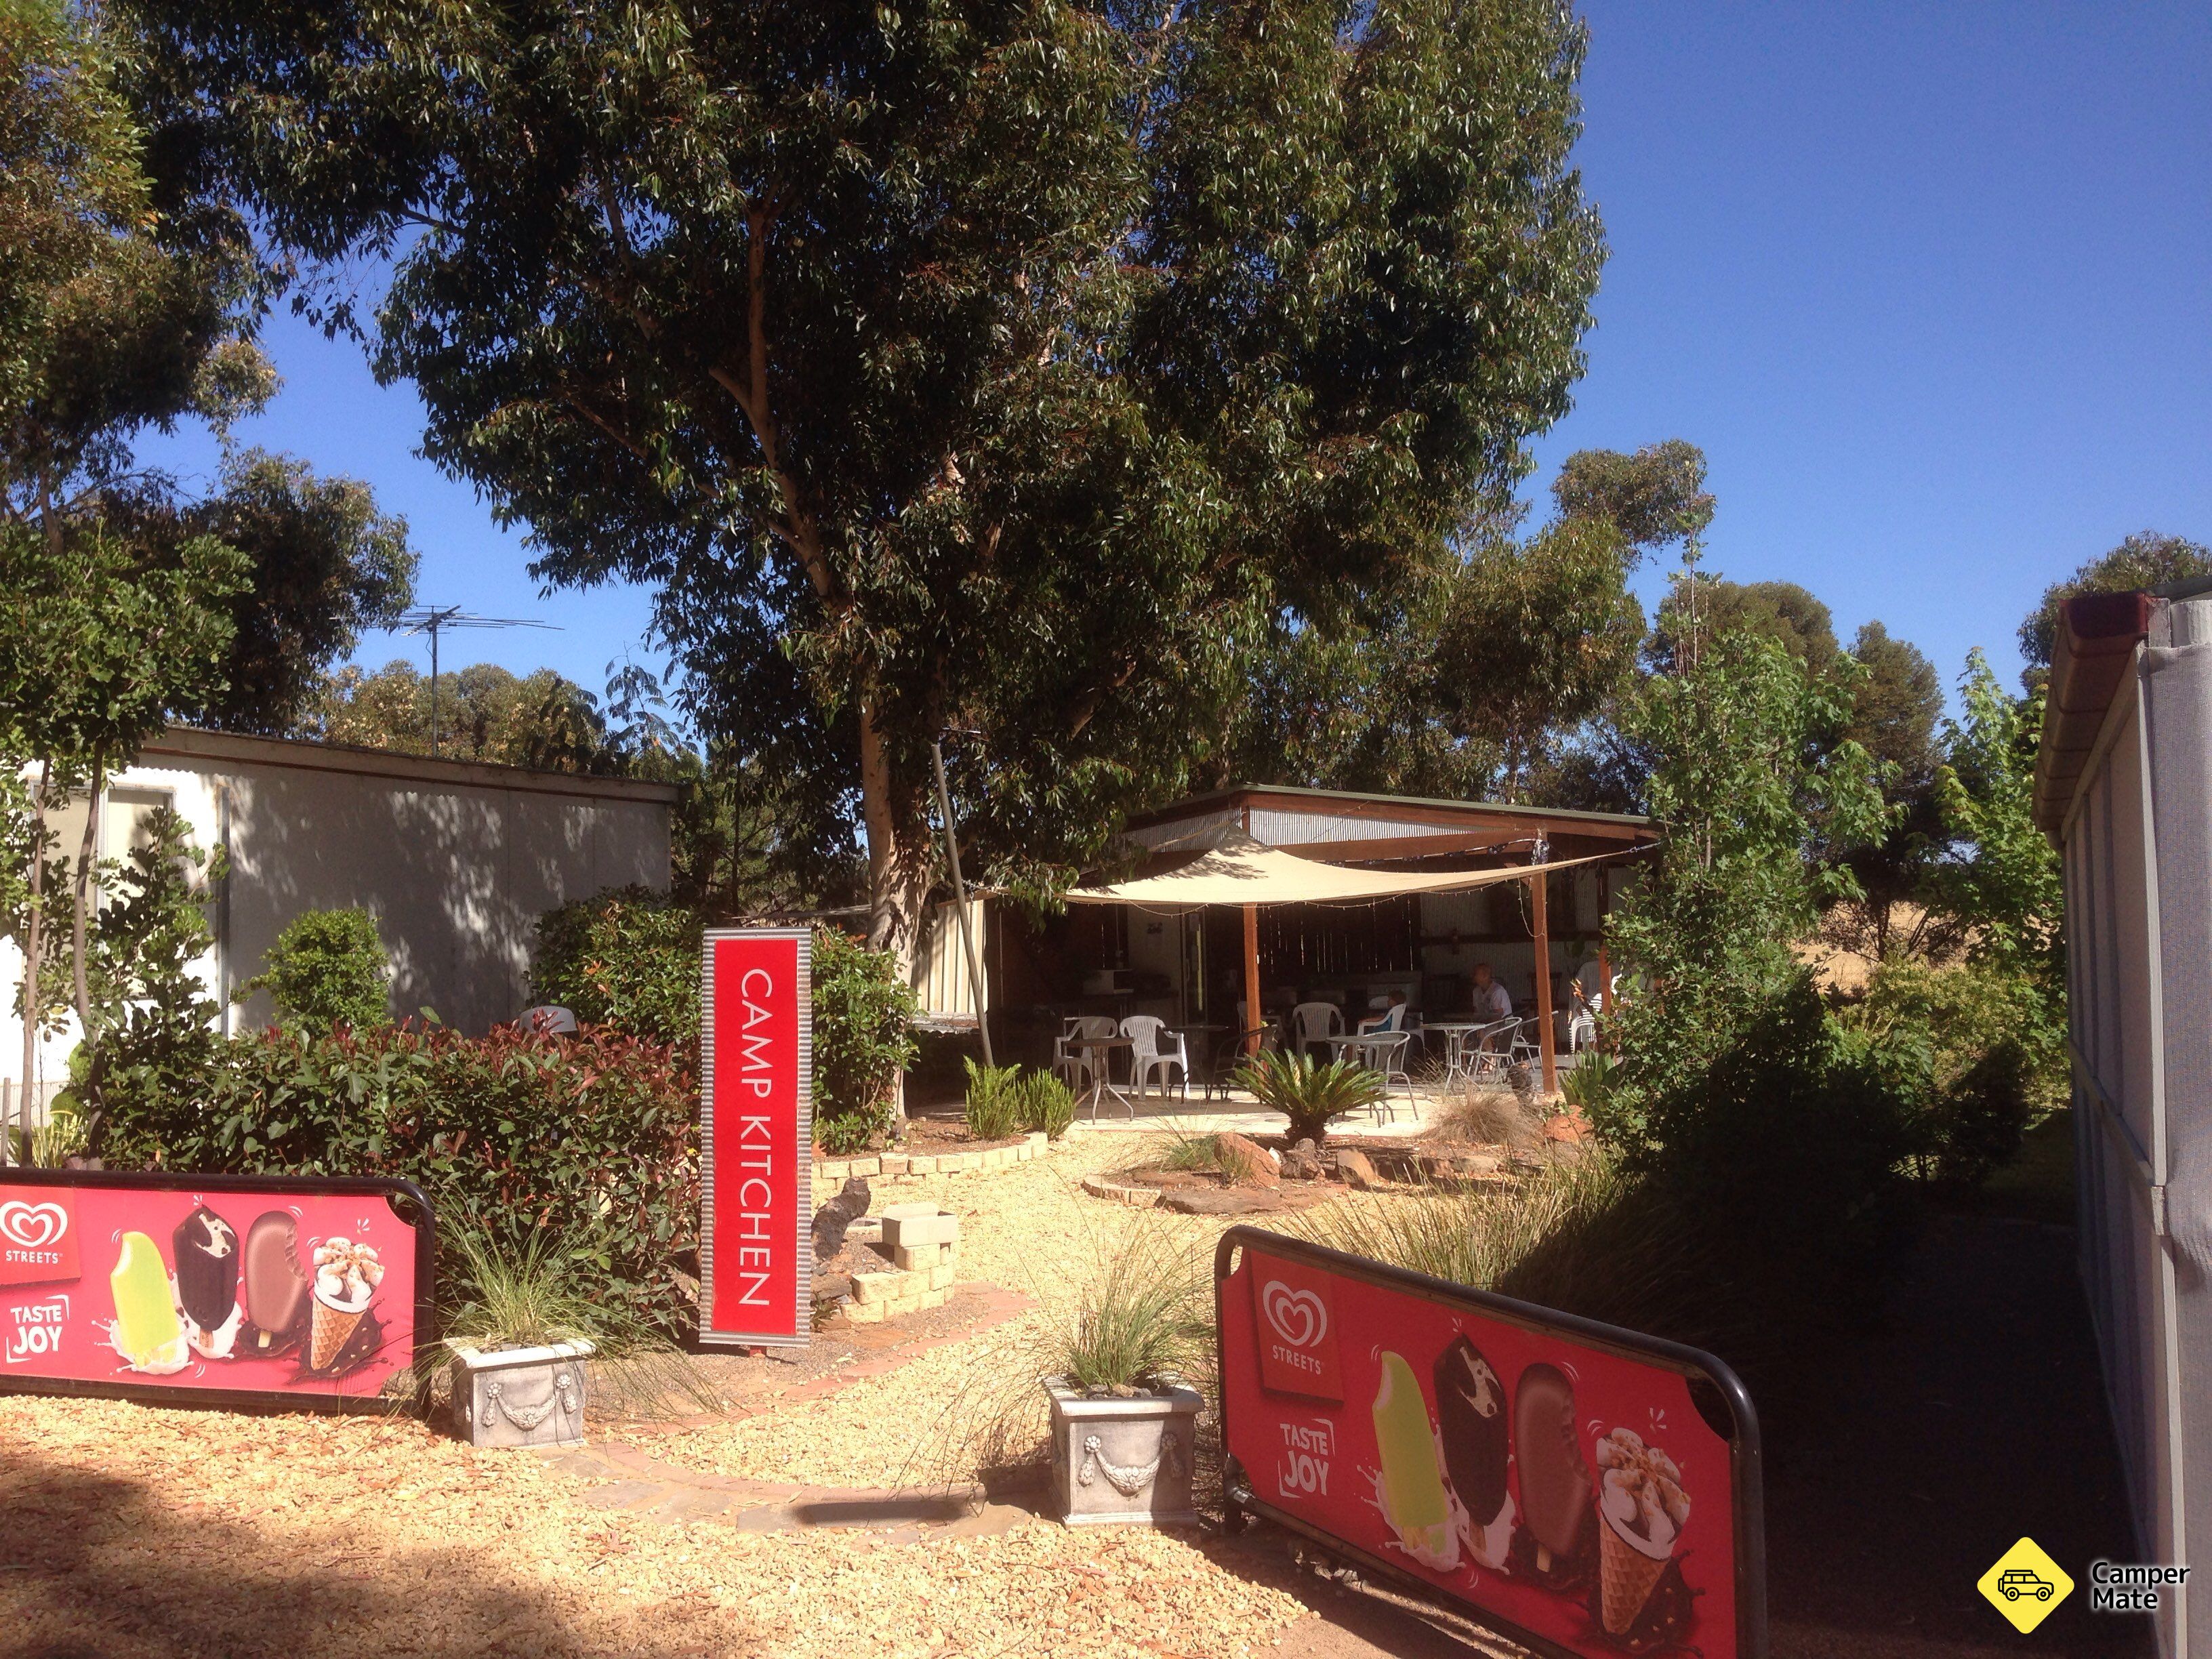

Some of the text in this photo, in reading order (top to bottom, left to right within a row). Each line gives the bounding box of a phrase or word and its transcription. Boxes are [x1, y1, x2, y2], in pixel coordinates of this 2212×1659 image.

[739, 968, 773, 1307] CAMP KITCHEN
[5, 1250, 58, 1264] STREETS
[11, 1305, 62, 1324] TASTE
[12, 1325, 62, 1355] JOY
[1273, 1345, 1321, 1375] STREETS
[1280, 1424, 1328, 1455] TASTE
[1284, 1450, 1329, 1496] JOY
